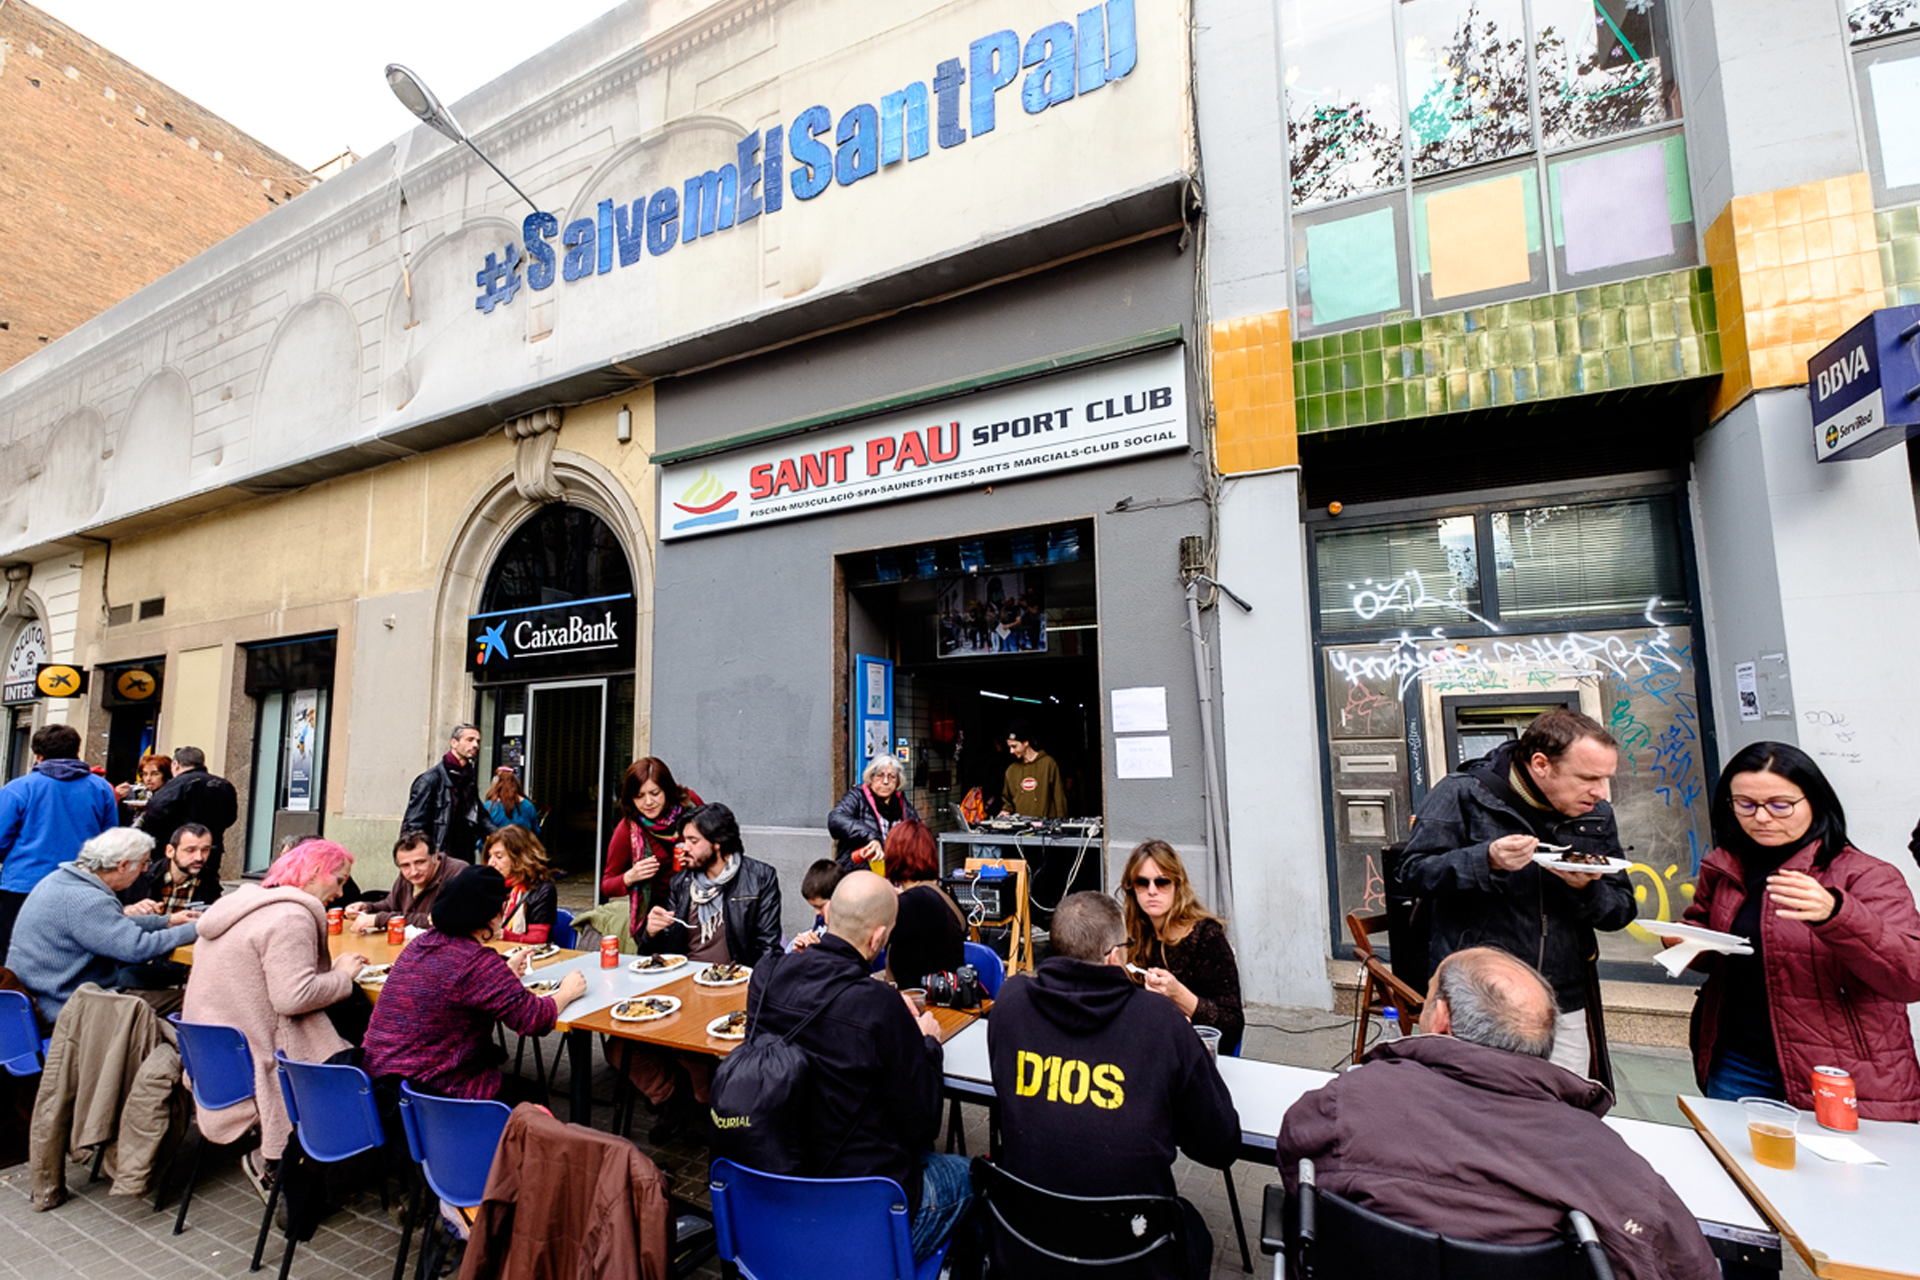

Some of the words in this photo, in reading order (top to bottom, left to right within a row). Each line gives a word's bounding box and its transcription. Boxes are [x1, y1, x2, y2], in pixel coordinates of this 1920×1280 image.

[1817, 345, 1871, 402] BBVA
[750, 445, 854, 500] SANT
[866, 421, 960, 477] PAU
[972, 406, 1074, 447] SPORT
[1085, 386, 1173, 424] CLUB
[1123, 430, 1177, 448] SOCIAL
[1839, 409, 1874, 439] ServiRed
[513, 611, 619, 650] CaixaBank
